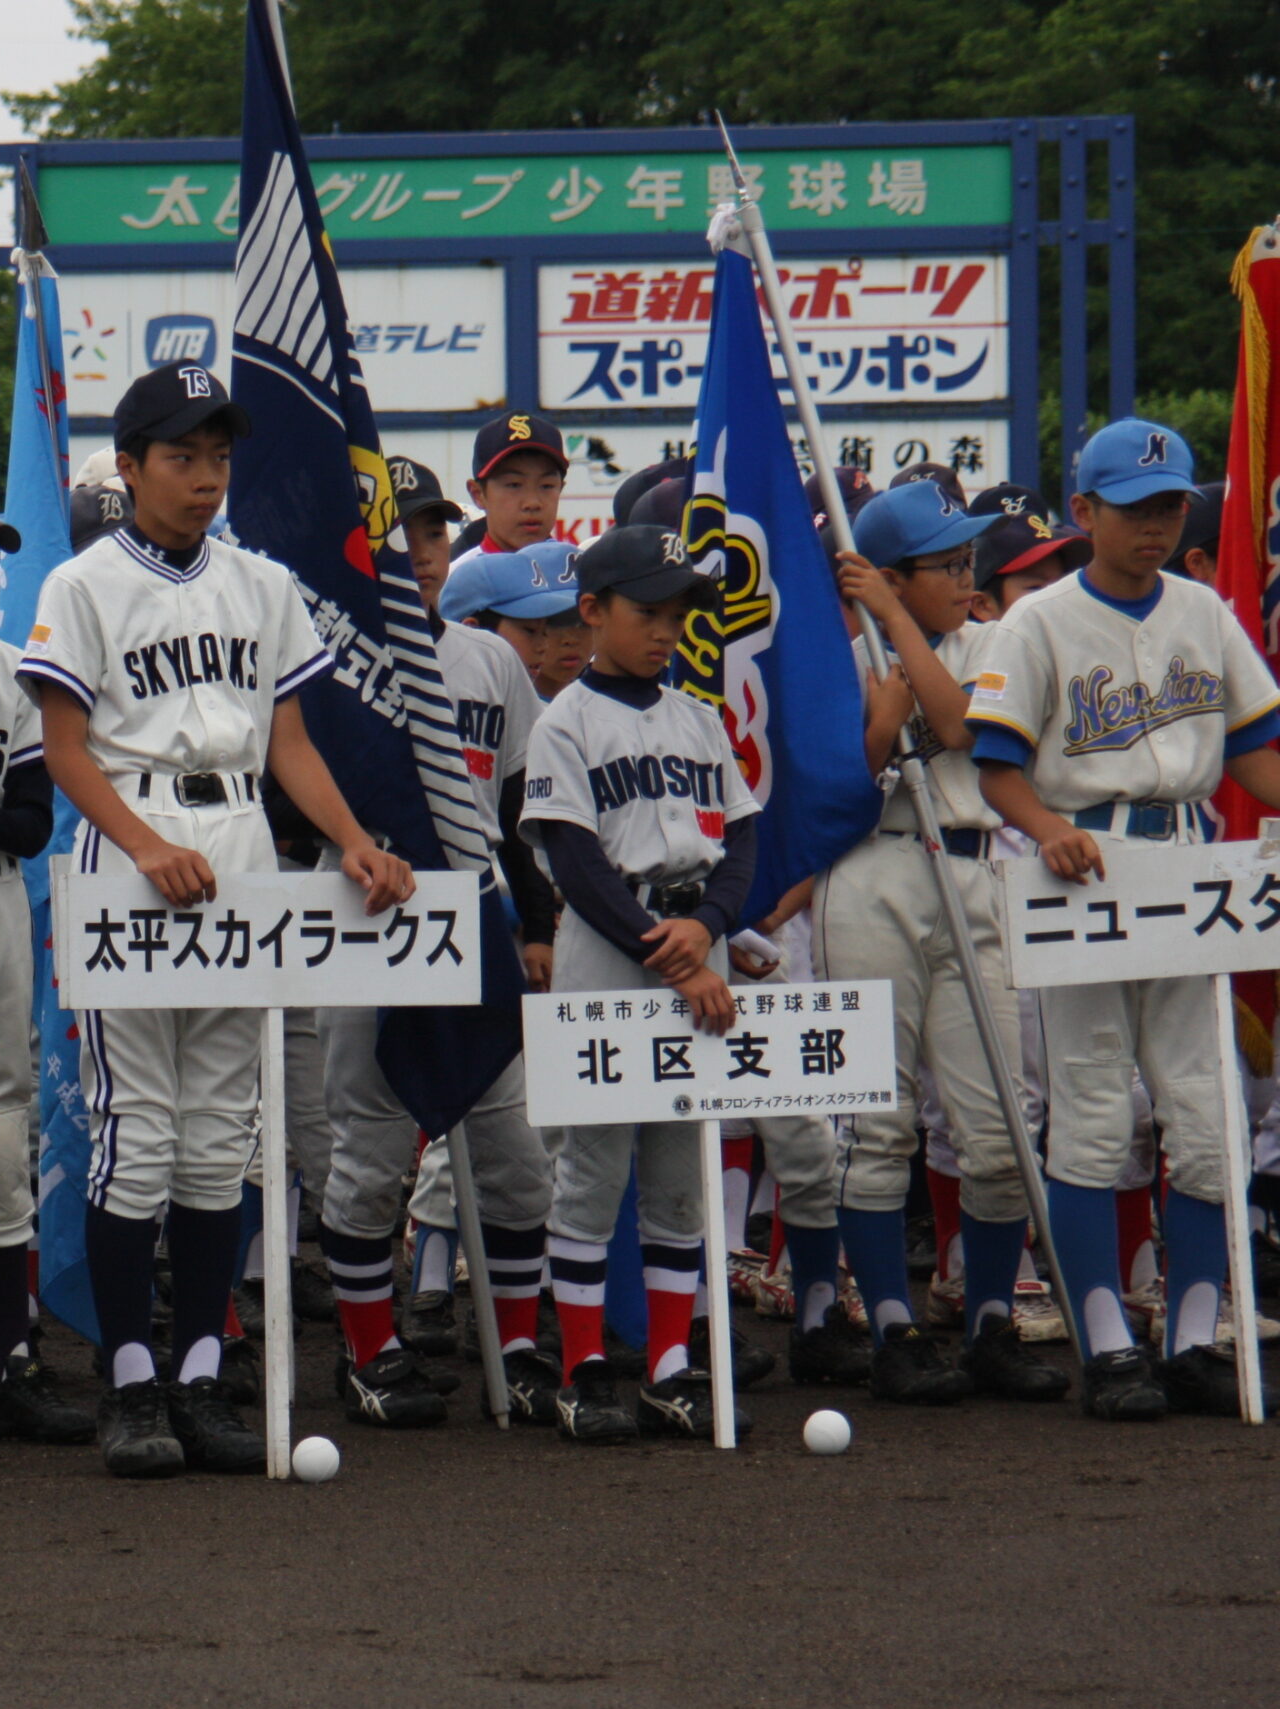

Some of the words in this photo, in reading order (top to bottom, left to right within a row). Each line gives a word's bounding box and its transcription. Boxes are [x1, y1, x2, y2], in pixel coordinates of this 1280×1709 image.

[121, 169, 526, 235] 太グループ
[547, 159, 928, 222] 少年野球場
[562, 256, 986, 325] 道新ポーツ
[152, 327, 210, 361] HTB
[179, 366, 212, 399] TS
[84, 907, 464, 974] 太平スカイラークス
[557, 990, 861, 1024] 札幌市少年式野球連盟
[577, 1028, 846, 1085] 北区支部
[699, 1090, 893, 1113] 札幌フロンティアライオンズクラブ寄贈
